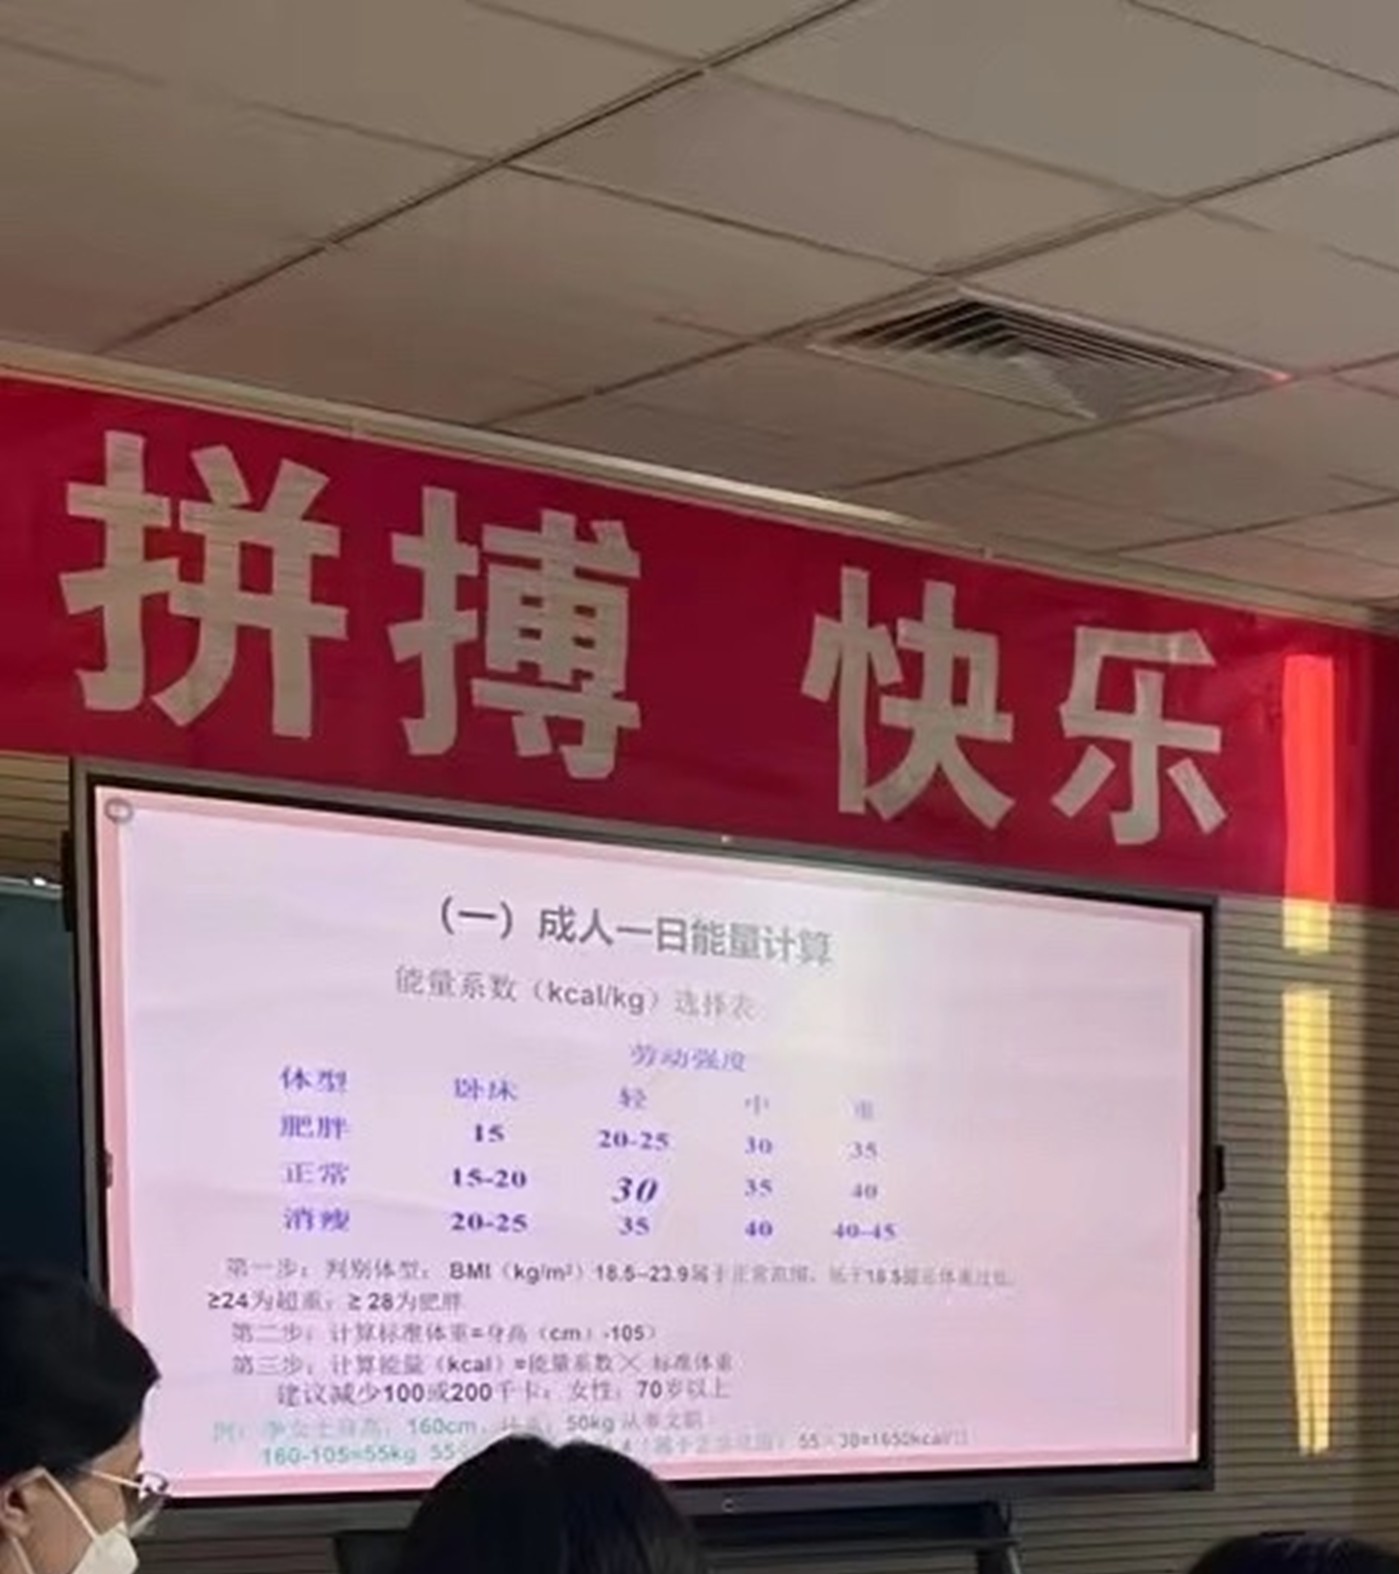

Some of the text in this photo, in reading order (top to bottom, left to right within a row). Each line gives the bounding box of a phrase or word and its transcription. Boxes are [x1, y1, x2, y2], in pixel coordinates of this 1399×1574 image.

[59, 430, 1228, 846] 拼搏 快乐
[629, 1042, 748, 1073] 劳动强度
[279, 1065, 350, 1094] 体型
[452, 1077, 519, 1103] 卧床
[743, 1093, 771, 1117] 中
[279, 1113, 351, 1140] 肥胖
[472, 1122, 506, 1144] 15
[597, 1128, 671, 1152] 20-25
[743, 1136, 774, 1157] 30
[848, 1140, 879, 1160] 35
[283, 1160, 351, 1187] 正常
[450, 1167, 528, 1191] 15-20
[610, 1174, 659, 1205] 30
[743, 1176, 774, 1197] 35
[850, 1181, 879, 1201] 40
[283, 1206, 352, 1234] 消瘦
[449, 1211, 529, 1235] 20-25
[617, 1215, 650, 1237] 35
[743, 1218, 774, 1239] 40
